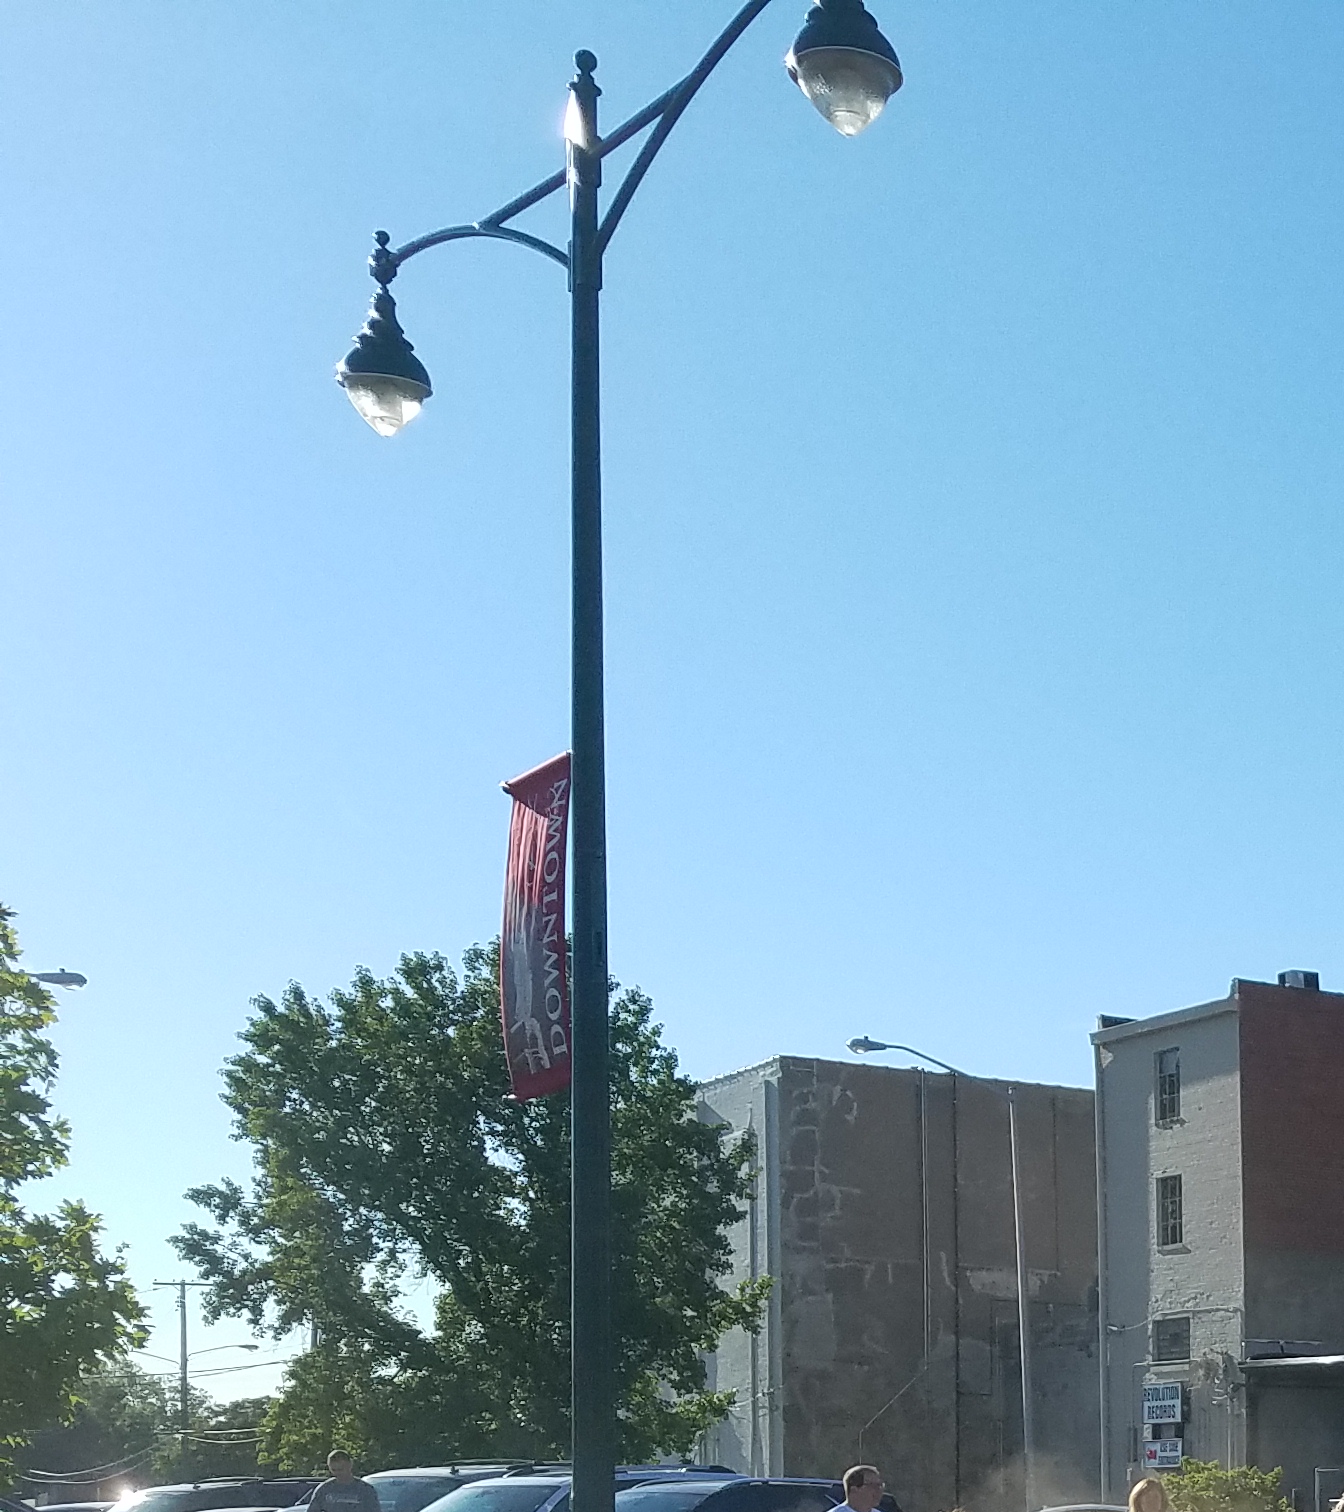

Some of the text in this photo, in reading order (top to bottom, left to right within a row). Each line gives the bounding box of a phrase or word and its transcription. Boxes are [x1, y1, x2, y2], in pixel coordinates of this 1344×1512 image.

[541, 777, 568, 1056] DOWNTOWN
[1143, 1386, 1180, 1402] REVOLUTION
[1147, 1404, 1176, 1420] RECORDS
